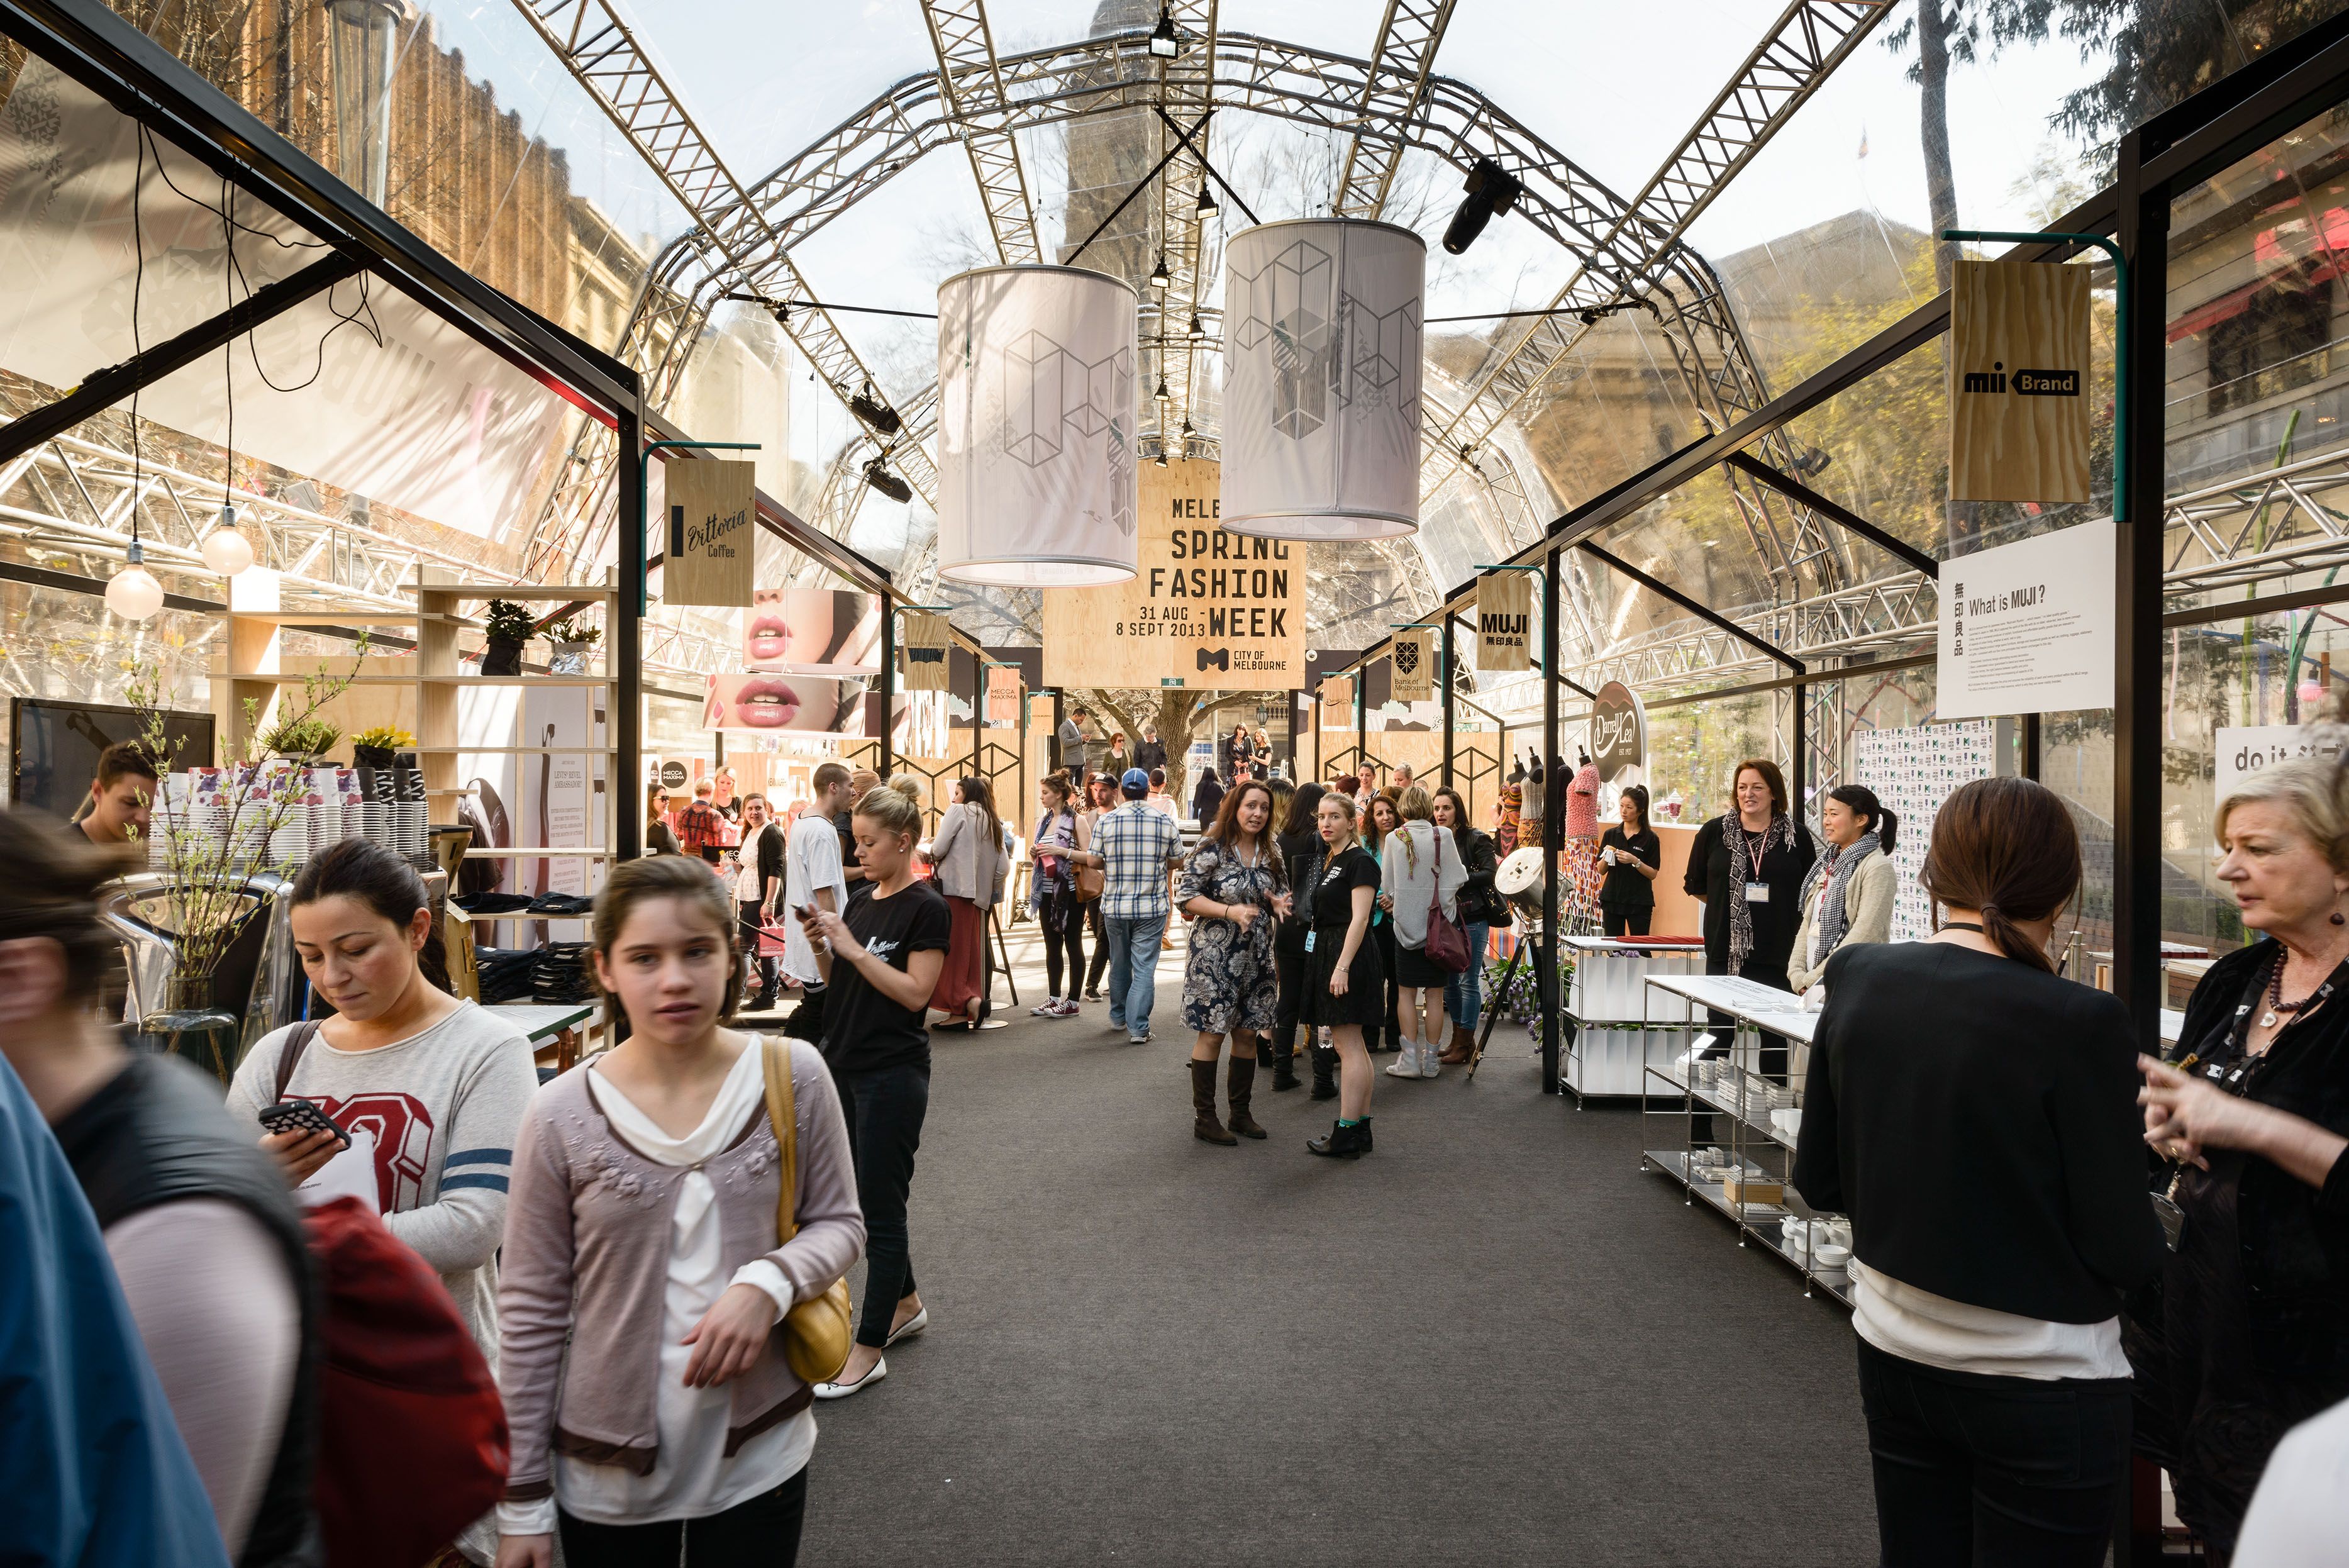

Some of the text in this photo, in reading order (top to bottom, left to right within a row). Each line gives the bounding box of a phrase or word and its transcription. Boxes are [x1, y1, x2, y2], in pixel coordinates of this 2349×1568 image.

[1964, 362, 2074, 393] mii Brand
[688, 509, 747, 551] Vittoria
[708, 544, 735, 558] Coffee
[1172, 530, 1288, 560] SPRING
[1150, 568, 1287, 598] FASHION
[1140, 606, 1156, 620] 31
[1163, 607, 1188, 620] AUG
[1969, 596, 1996, 616] What
[1999, 594, 2007, 611] is
[2011, 586, 2036, 609] MUJI
[1116, 623, 1205, 637] 8 SEPT 2013
[1209, 608, 1287, 637] WEEK
[1482, 613, 1527, 634] MUJI
[1954, 582, 1963, 657] 無印良品
[1486, 636, 1523, 647] 無印良品
[1234, 651, 1265, 660] CITY OF
[1234, 661, 1287, 670] MELBOURNE
[1596, 712, 1633, 745] Darrell Lea
[2235, 746, 2263, 771] do
